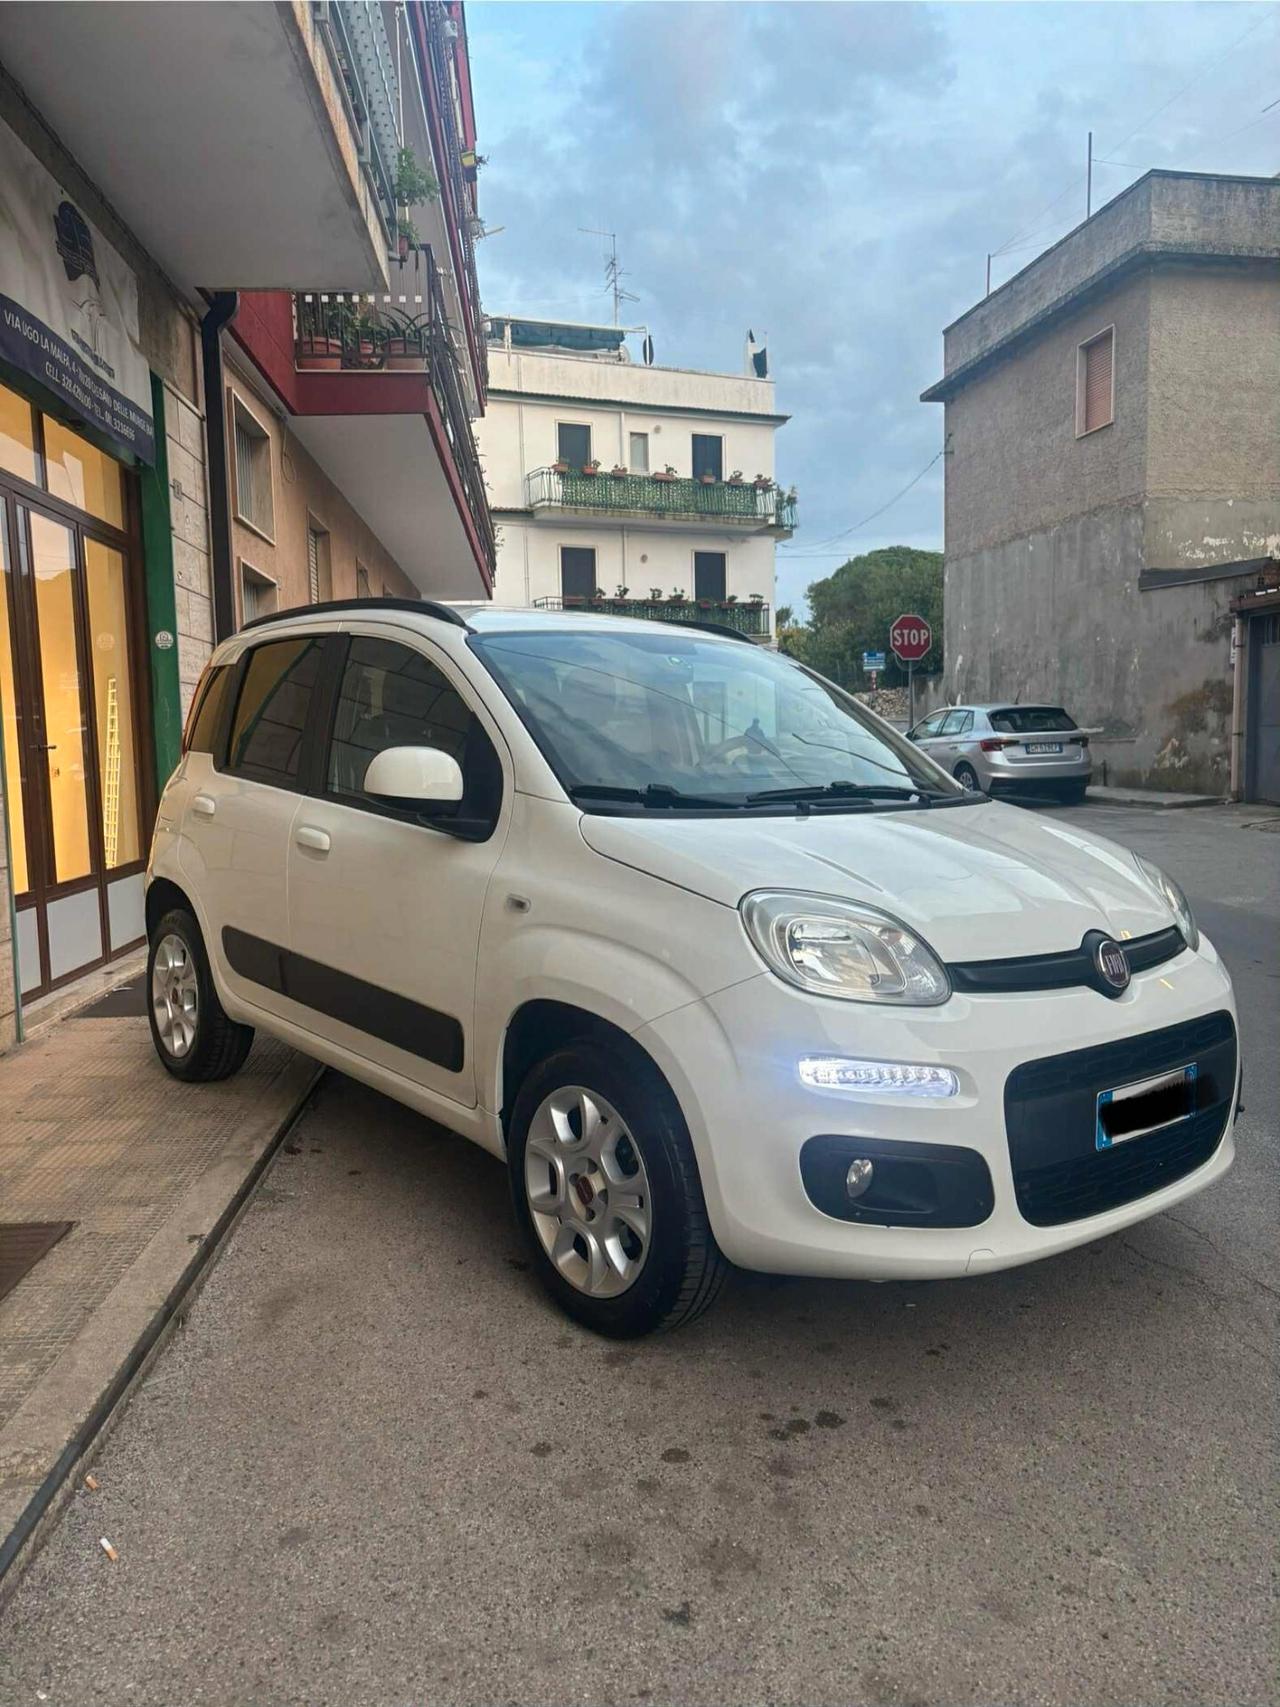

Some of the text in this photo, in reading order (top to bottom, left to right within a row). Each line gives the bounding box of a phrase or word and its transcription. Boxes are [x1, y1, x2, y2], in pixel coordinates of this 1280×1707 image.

[4, 310, 21, 333] VIA
[22, 320, 39, 344] UGO
[40, 335, 50, 352] LA
[113, 399, 129, 419] DELLE
[893, 628, 929, 646] STOP
